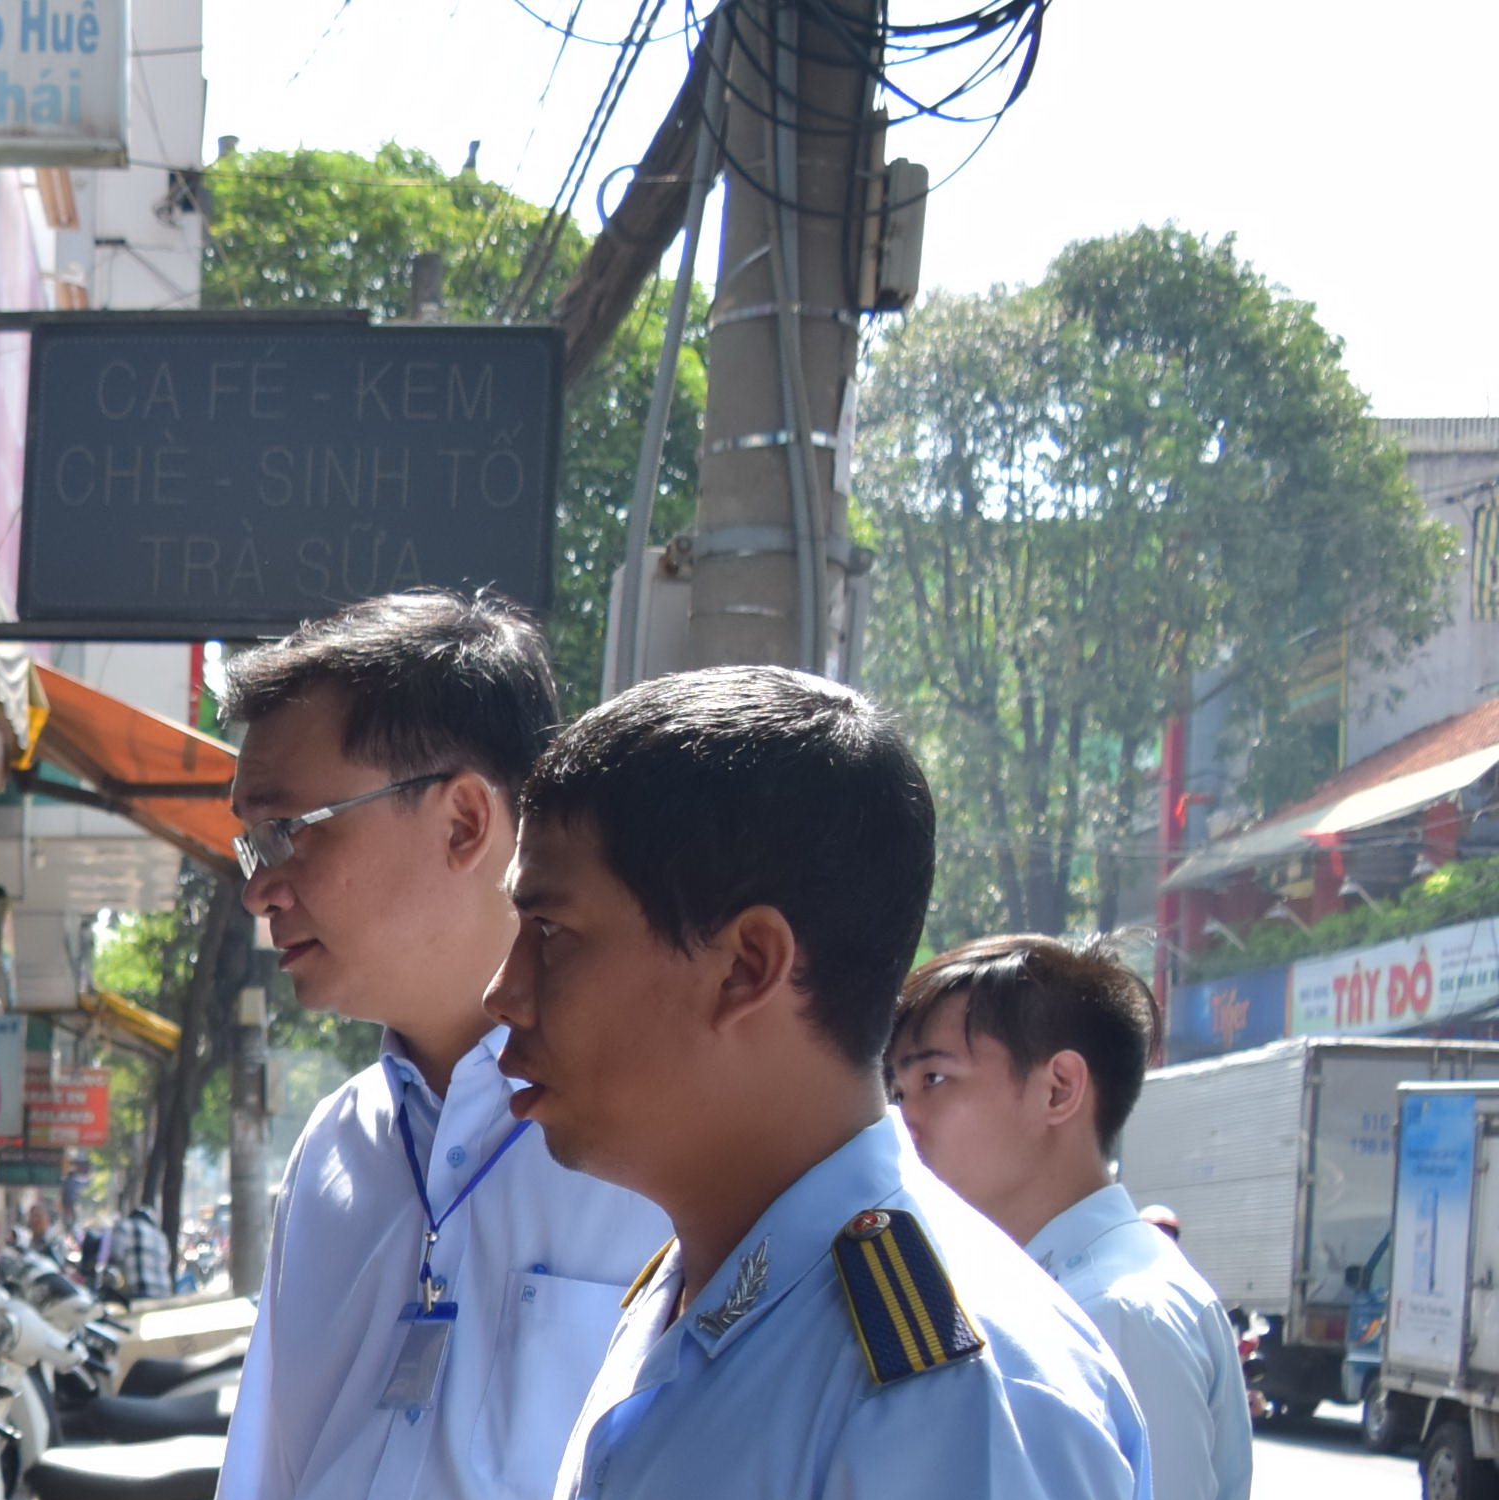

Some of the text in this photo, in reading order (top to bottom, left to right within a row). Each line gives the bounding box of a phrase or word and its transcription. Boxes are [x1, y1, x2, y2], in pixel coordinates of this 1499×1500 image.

[356, 358, 495, 422] KEM
[55, 420, 526, 508] CHÈ SINH TỐ
[138, 518, 265, 597] TRÀ
[1332, 960, 1381, 1028] TÂY
[1387, 945, 1433, 1016] ĐÔ
